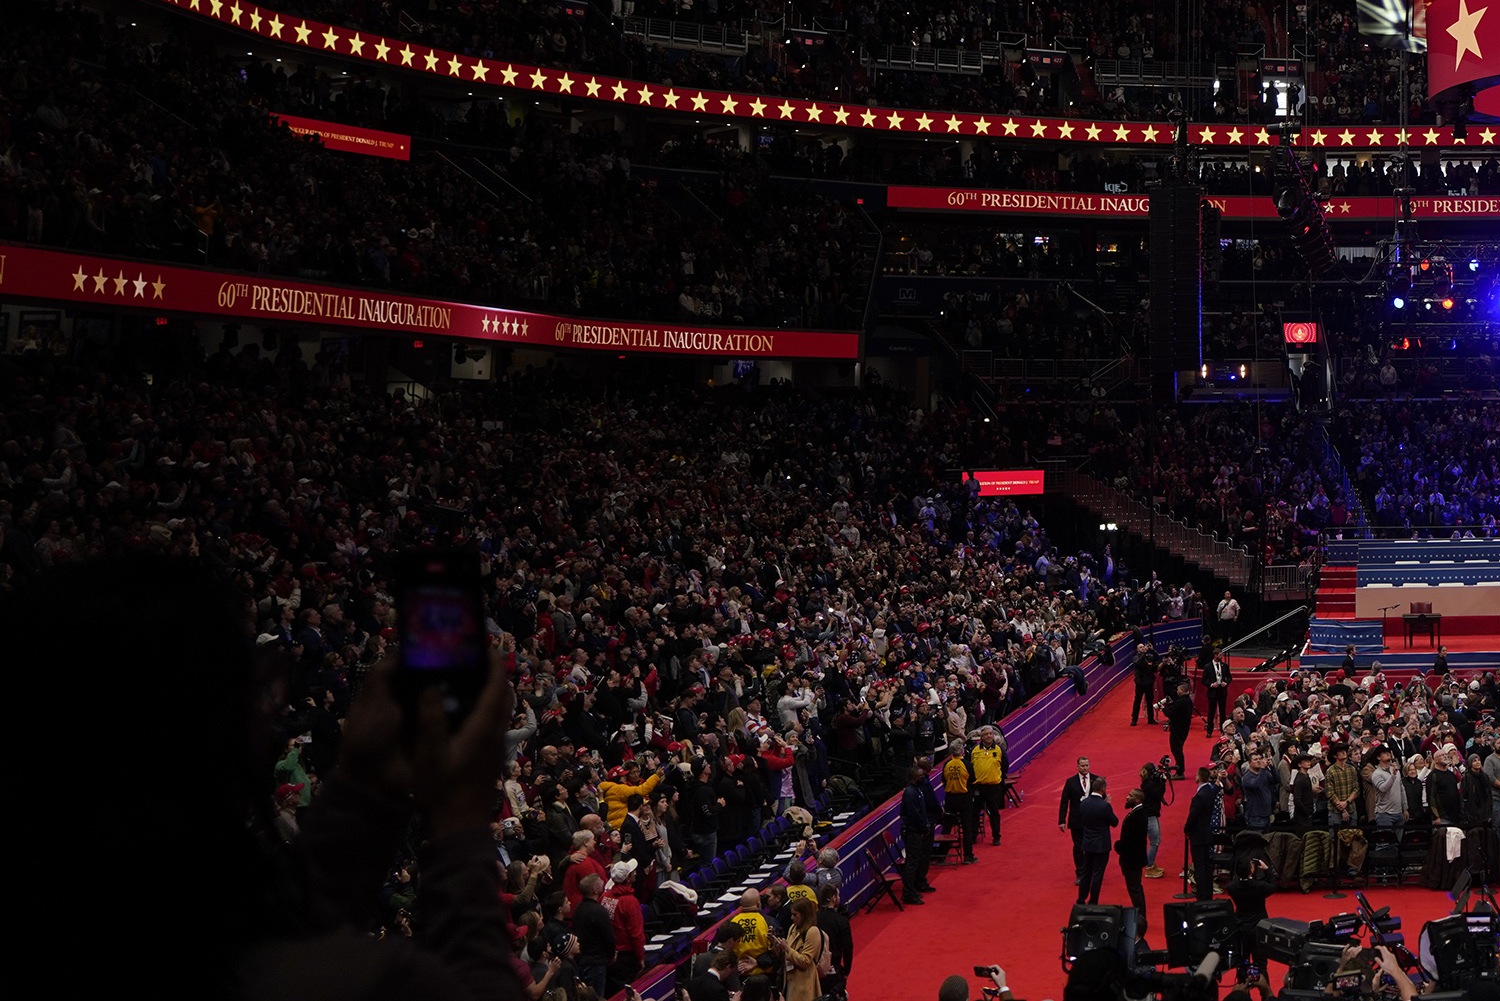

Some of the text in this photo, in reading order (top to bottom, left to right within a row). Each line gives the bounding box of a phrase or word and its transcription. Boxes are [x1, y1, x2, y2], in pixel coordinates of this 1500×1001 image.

[355, 136, 375, 146] DONALD
[378, 141, 394, 149] TRUMP
[947, 190, 1097, 212] 60TH PRESIDENTIAL
[217, 281, 450, 329] 60TH PRESIDENTIAL INAUGURATION
[555, 322, 774, 352] 60TH PRESIDENTIAL INAUGURATION
[789, 890, 807, 899] CSC
